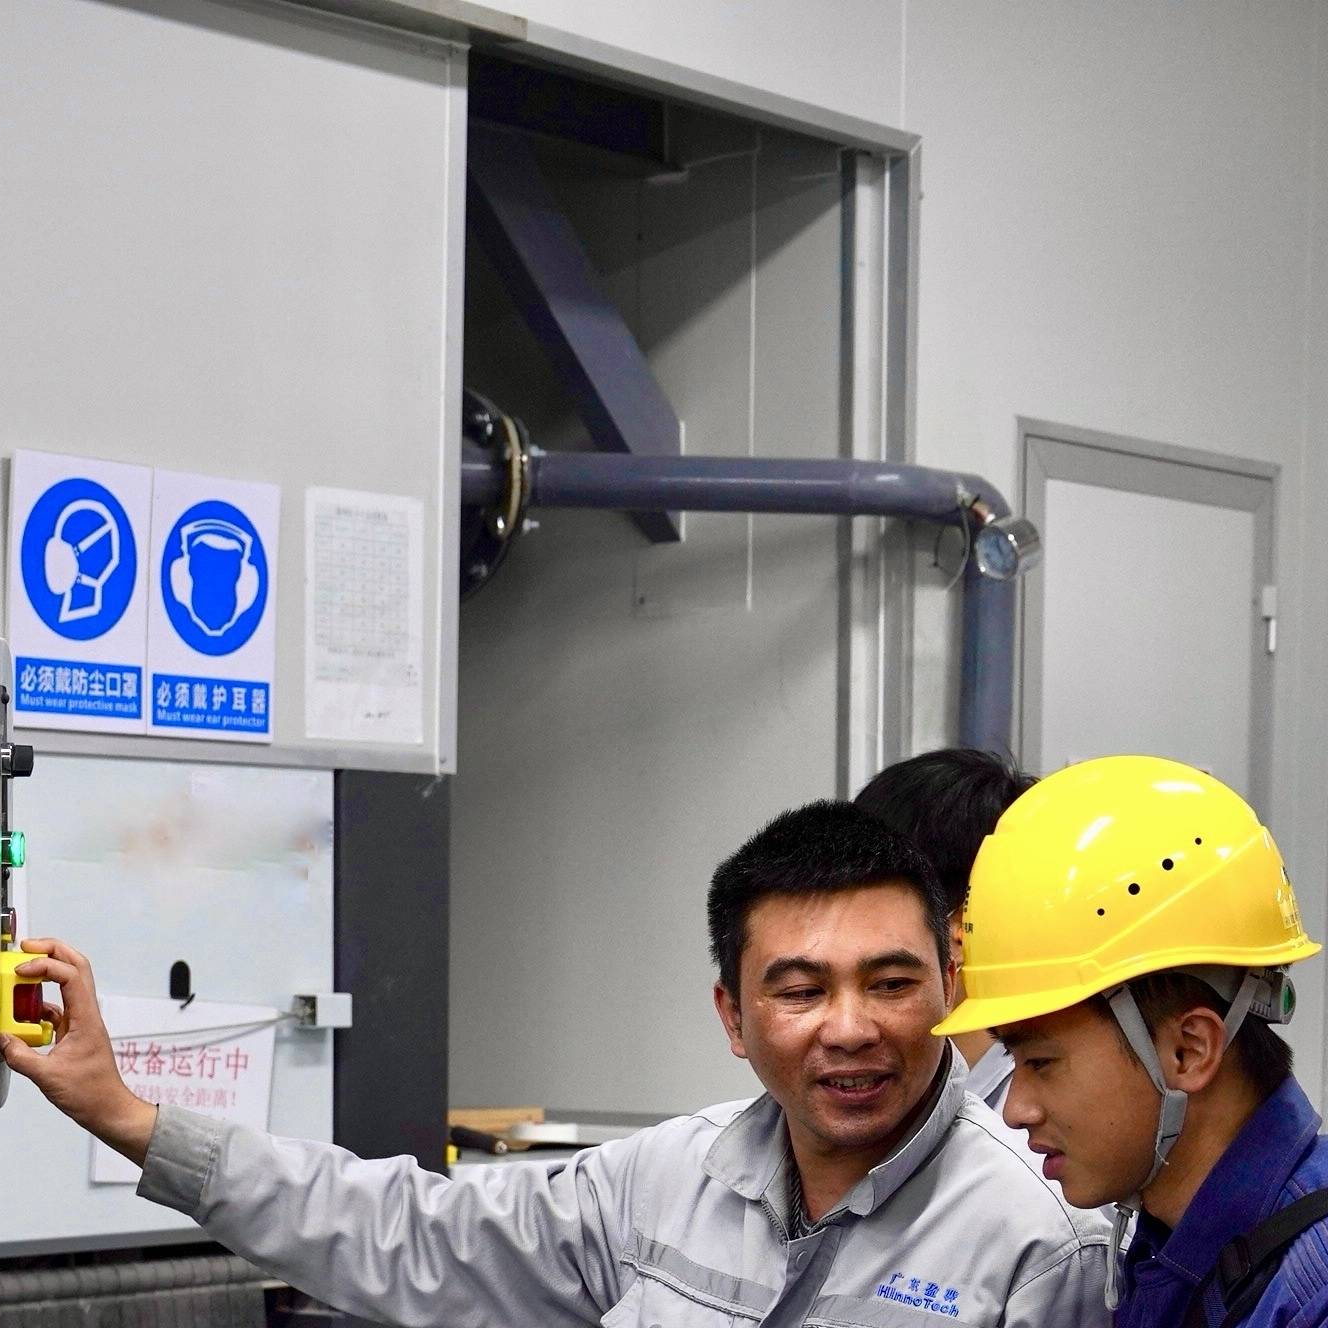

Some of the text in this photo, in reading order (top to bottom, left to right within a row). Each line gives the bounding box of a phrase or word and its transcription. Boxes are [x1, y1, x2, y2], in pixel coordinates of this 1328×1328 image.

[19, 664, 138, 698] 必须戴防尘口罩
[20, 693, 138, 713] Must wear protective mask
[156, 708, 265, 727] Must wear ear protector
[117, 1041, 249, 1081] 设备运行中
